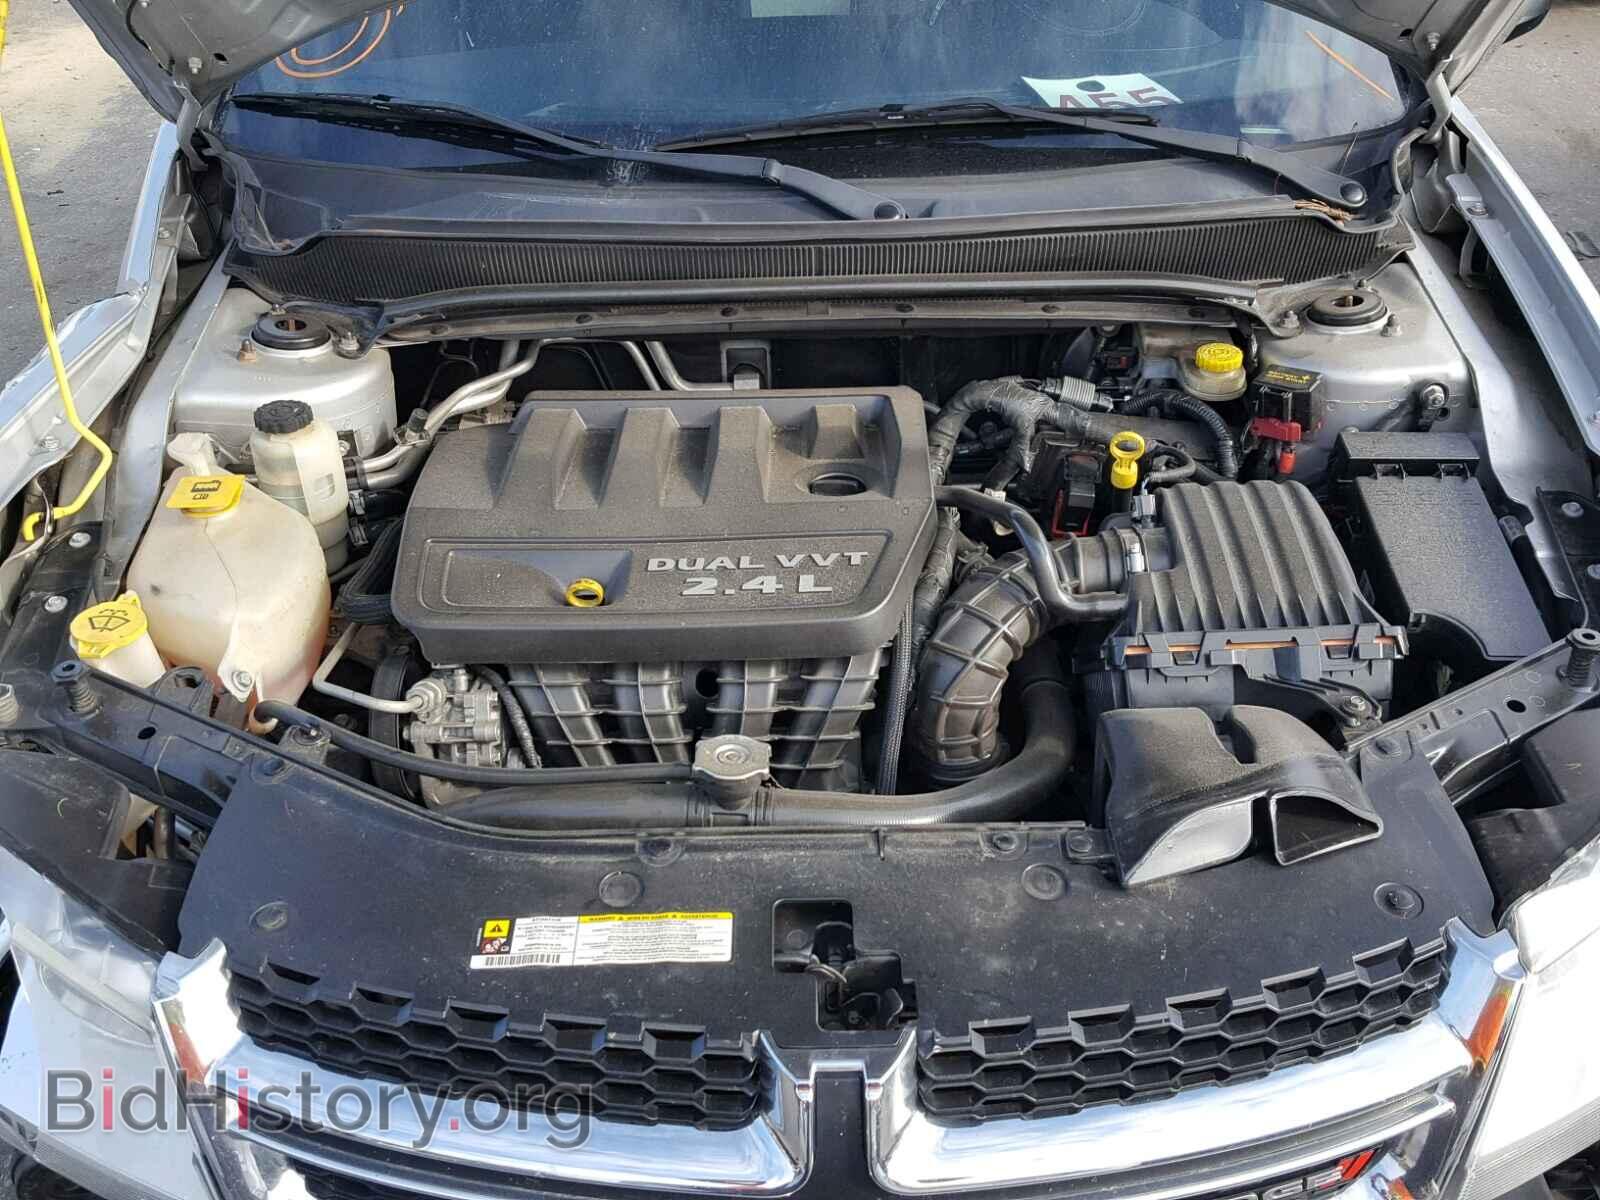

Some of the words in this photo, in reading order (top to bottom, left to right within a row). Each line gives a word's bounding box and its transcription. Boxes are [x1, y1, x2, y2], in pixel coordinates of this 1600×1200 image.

[647, 555, 765, 572] DUAL
[775, 551, 868, 568] VVT
[681, 575, 783, 597] 2.4
[799, 574, 833, 593] L
